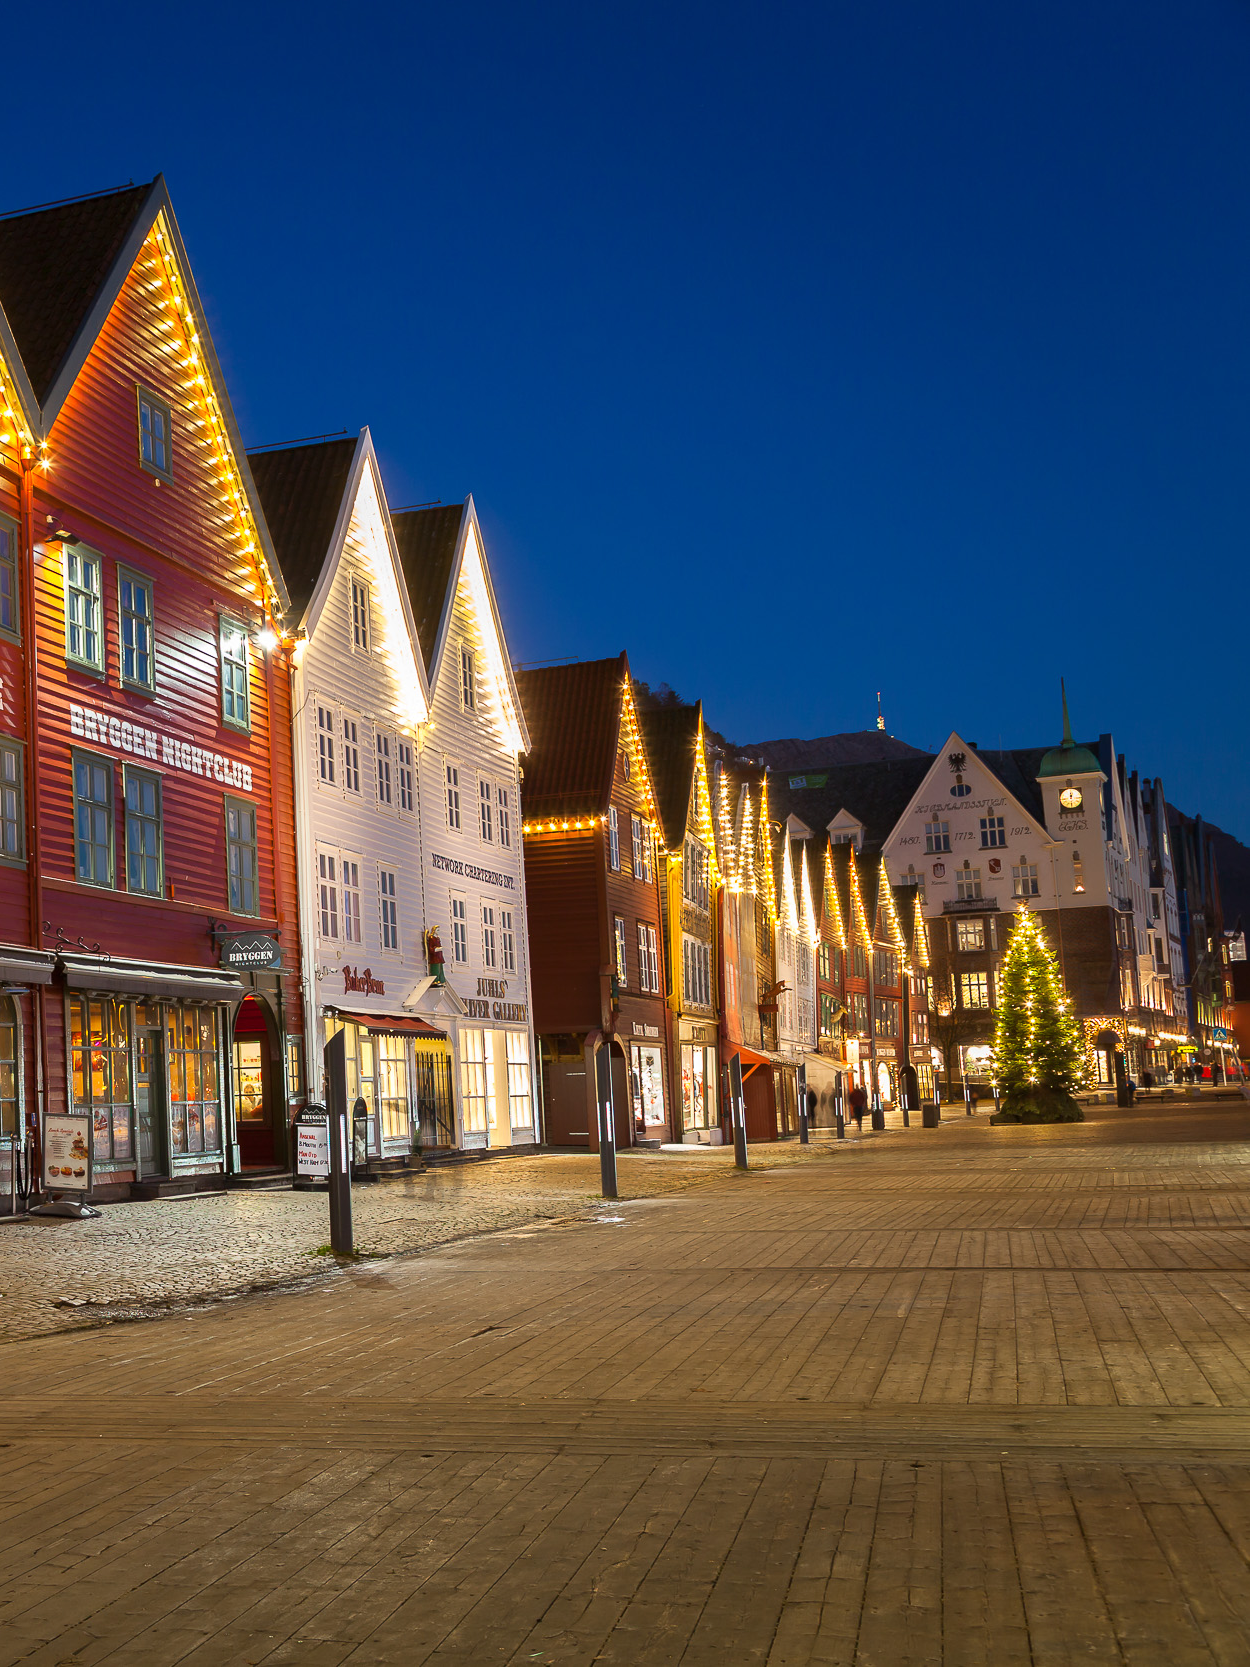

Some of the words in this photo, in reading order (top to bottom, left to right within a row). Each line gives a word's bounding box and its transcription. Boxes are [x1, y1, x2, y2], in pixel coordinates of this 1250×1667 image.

[69, 703, 158, 761] BRYGGEN
[161, 735, 253, 792] NIGHTCLUB
[431, 853, 464, 876] NETWORK
[229, 951, 273, 961] BRYGGEN
